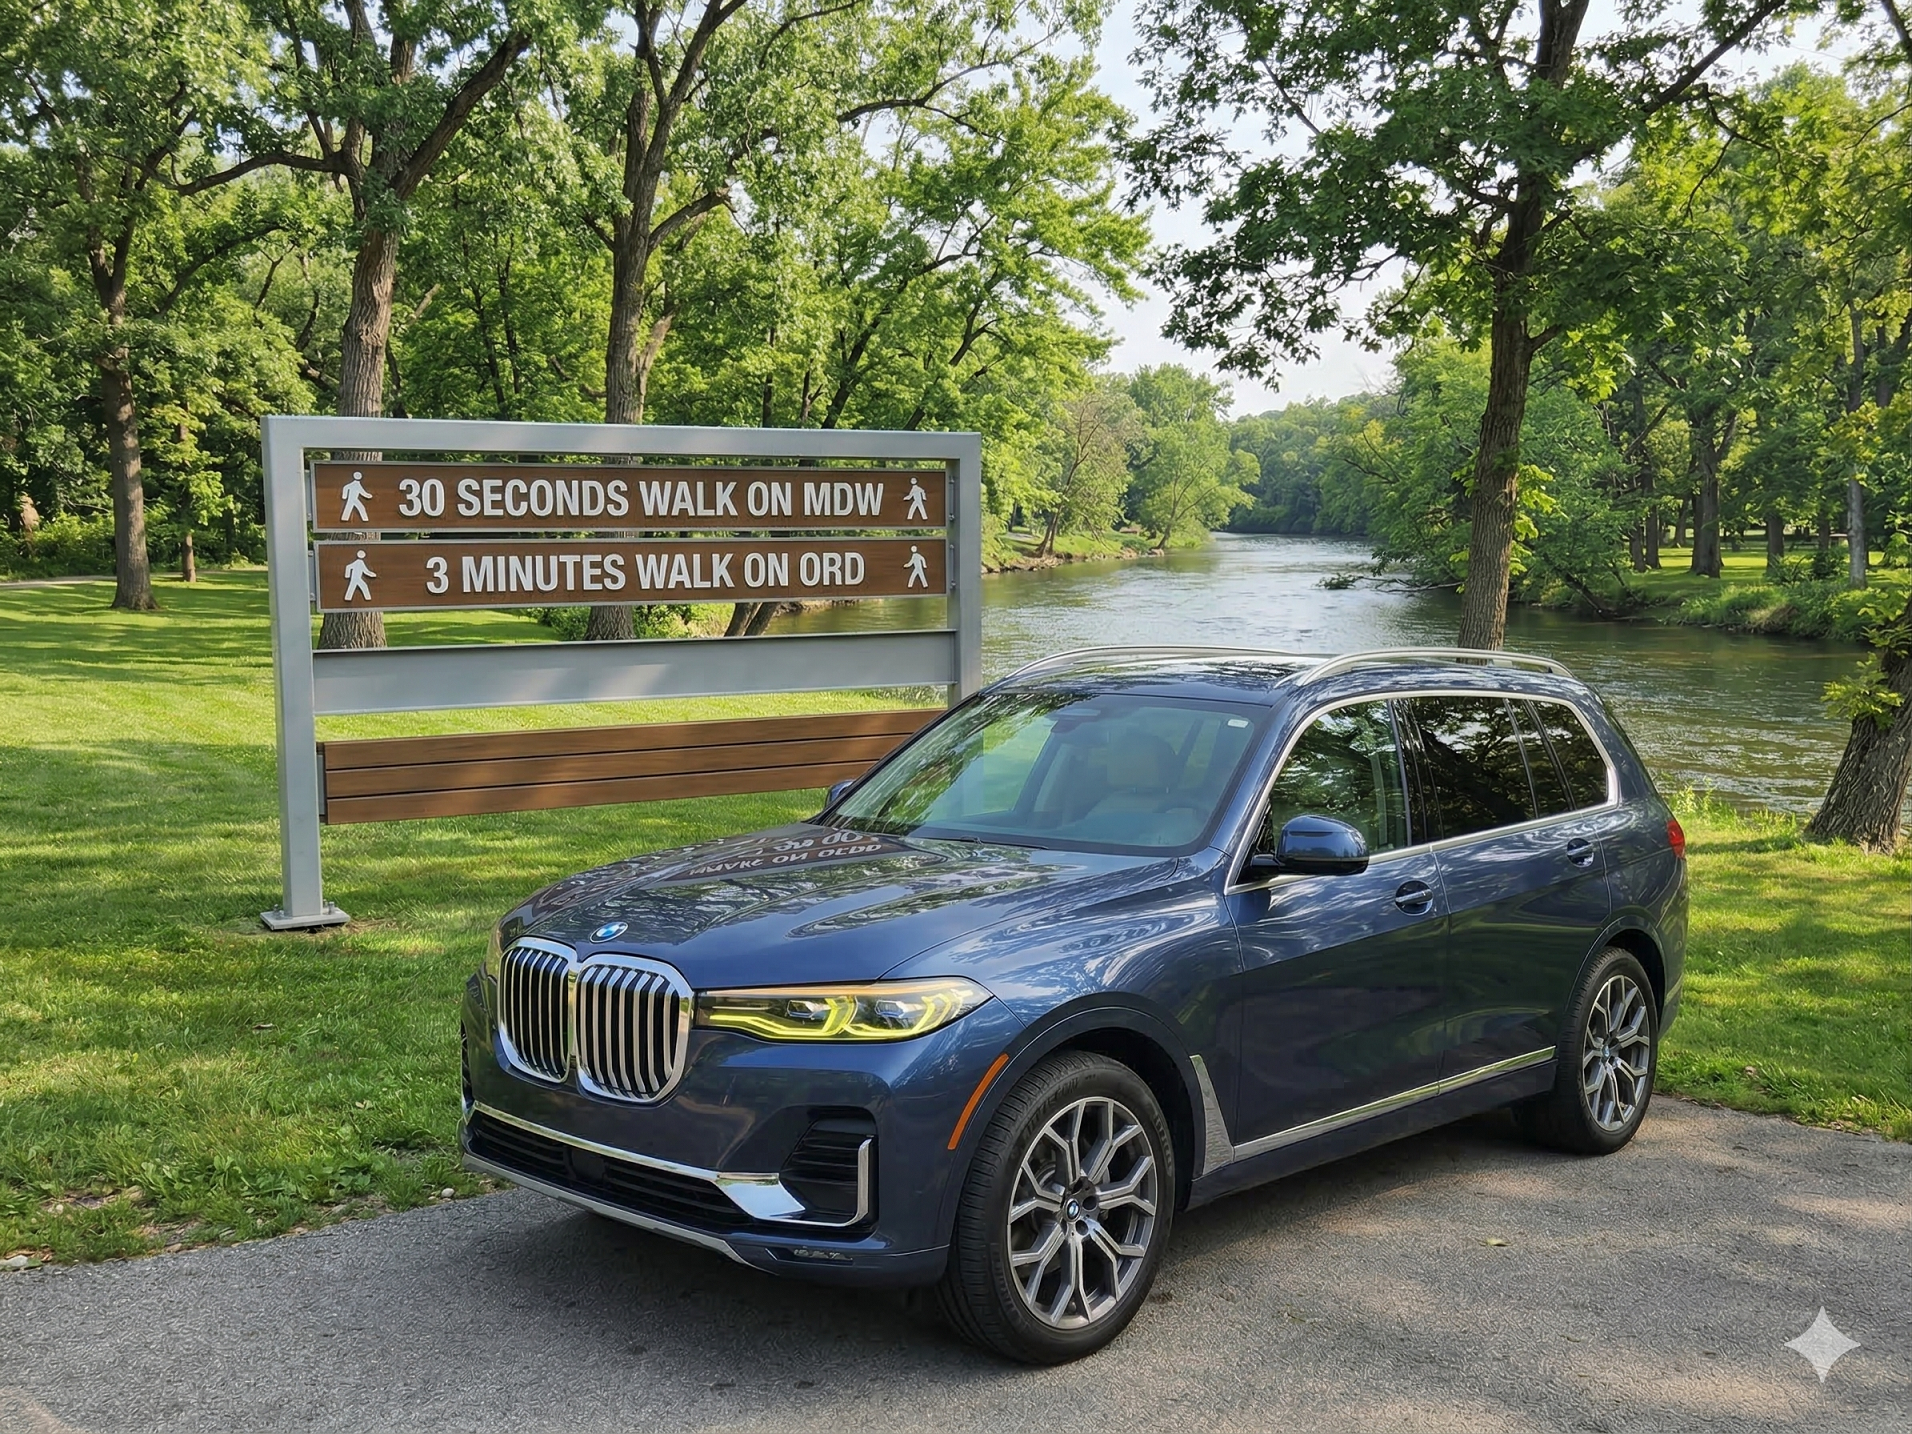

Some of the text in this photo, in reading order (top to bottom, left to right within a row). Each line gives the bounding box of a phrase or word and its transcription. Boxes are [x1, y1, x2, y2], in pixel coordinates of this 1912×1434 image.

[398, 478, 884, 517] 30 SECONDS WALK ON MDW
[426, 552, 865, 594] 3 MINUTES WALK ON ORD
